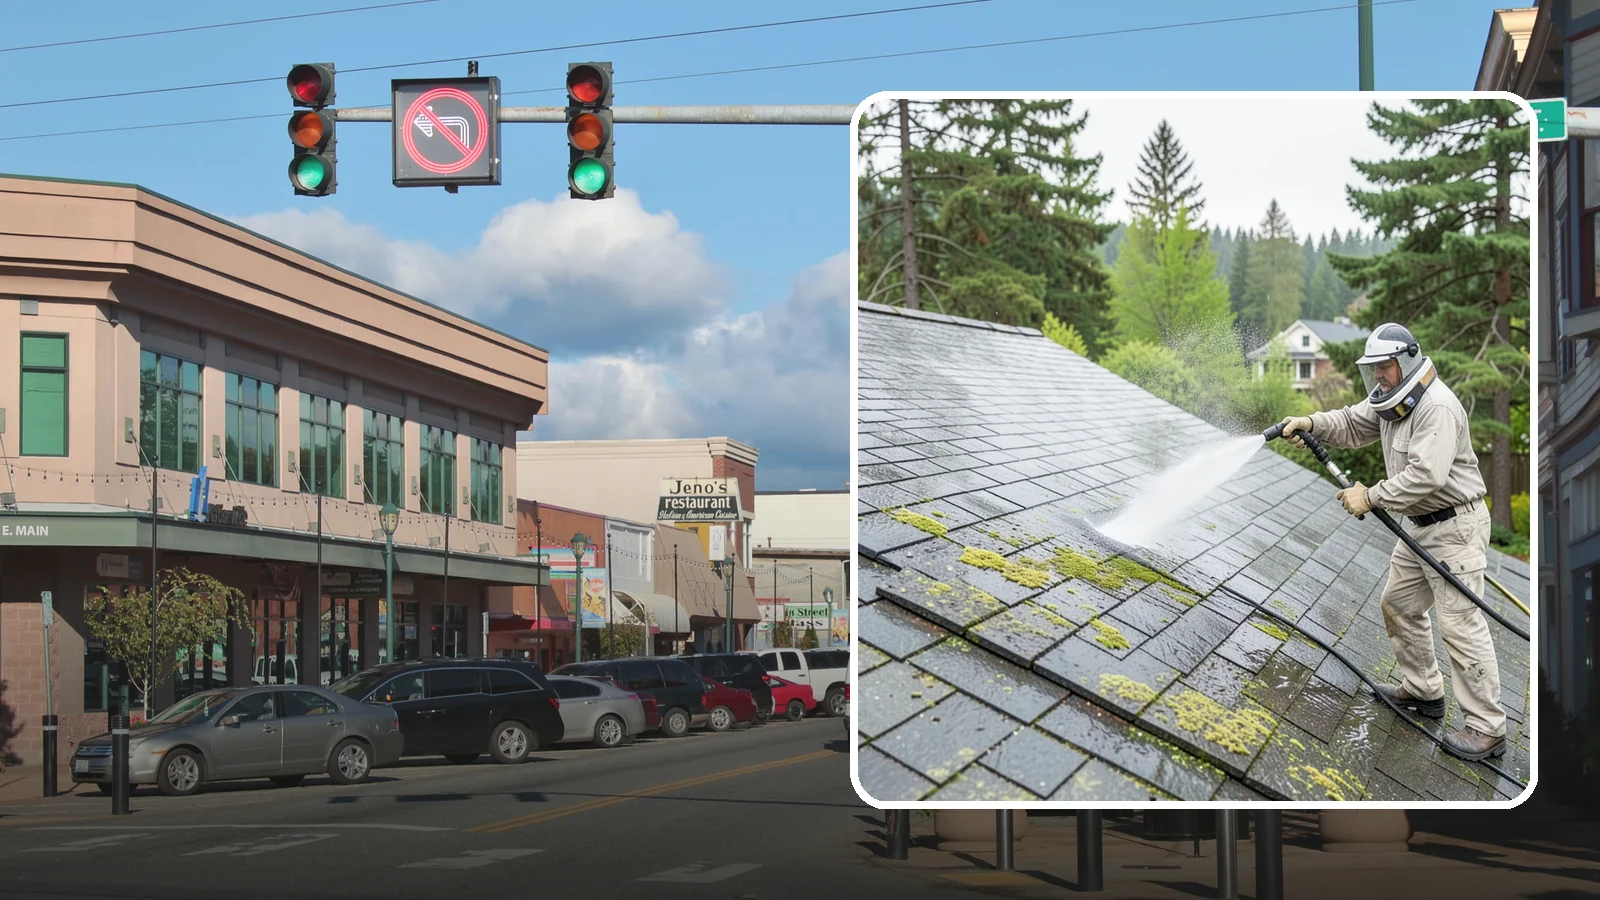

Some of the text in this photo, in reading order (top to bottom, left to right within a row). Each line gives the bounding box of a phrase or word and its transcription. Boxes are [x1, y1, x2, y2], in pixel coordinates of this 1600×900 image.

[670, 480, 728, 494] Jeno's
[665, 496, 731, 509] restaurant
[659, 510, 681, 519] Italian
[686, 509, 715, 519] American
[715, 509, 738, 519] Cuisine
[2, 525, 49, 536] E. MAIN
[797, 607, 828, 617] Street
